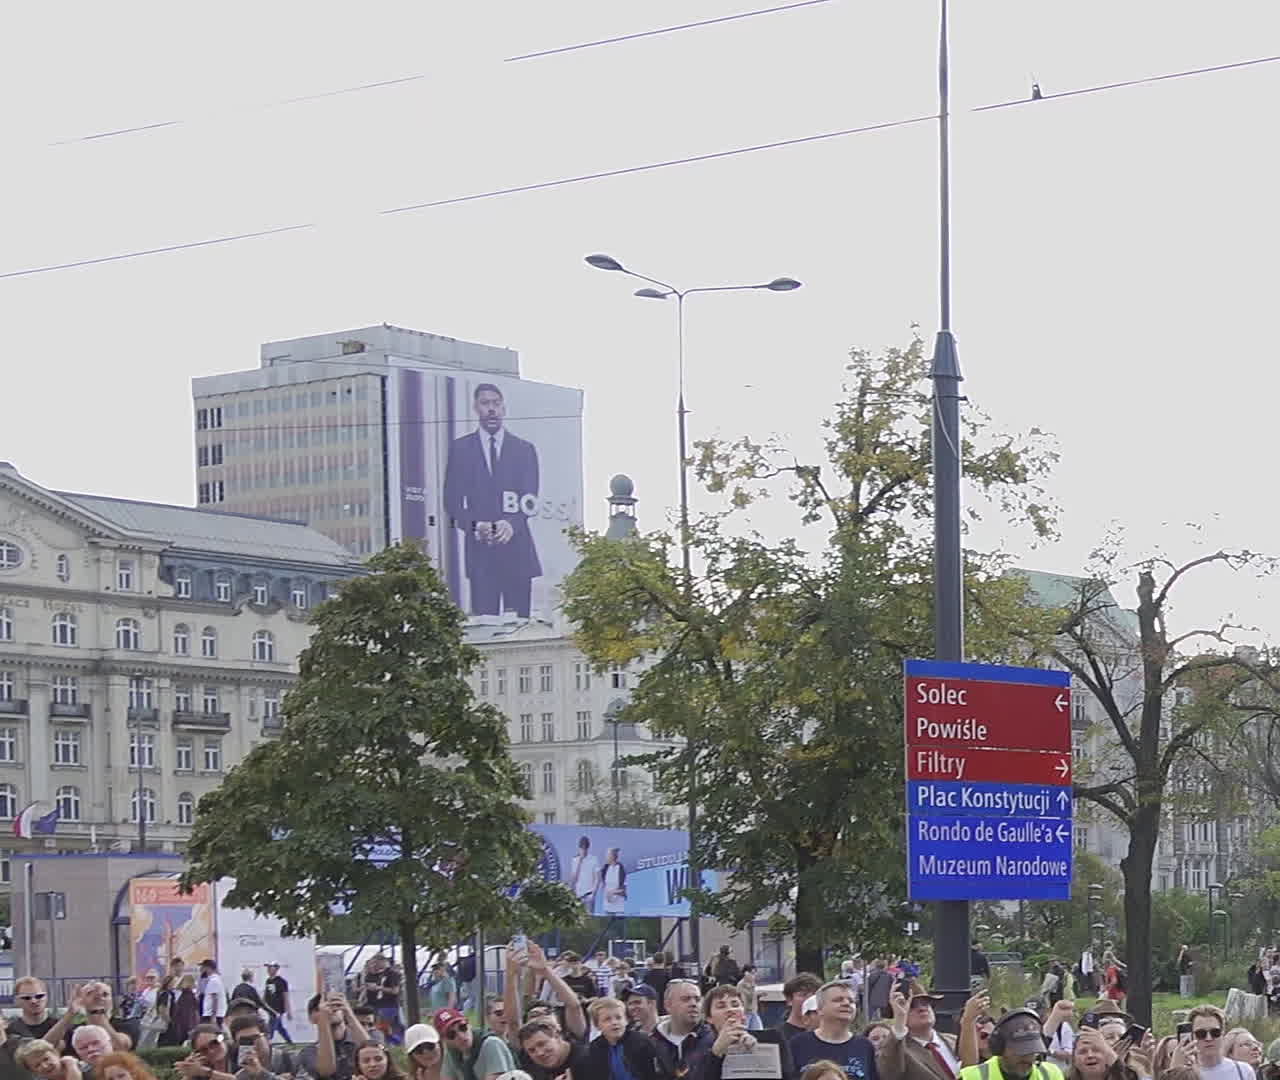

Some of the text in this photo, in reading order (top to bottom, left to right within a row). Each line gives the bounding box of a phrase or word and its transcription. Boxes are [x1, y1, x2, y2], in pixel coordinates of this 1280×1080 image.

[503, 491, 570, 520] BOSS
[917, 683, 968, 705] Solec
[917, 717, 988, 741] Powiśle
[917, 751, 965, 779] Filtry
[918, 785, 1050, 815] Plac Konstytucji
[919, 820, 1053, 843] Rondo de Gaulle'a
[919, 855, 1067, 876] Muzeum Narodowe
